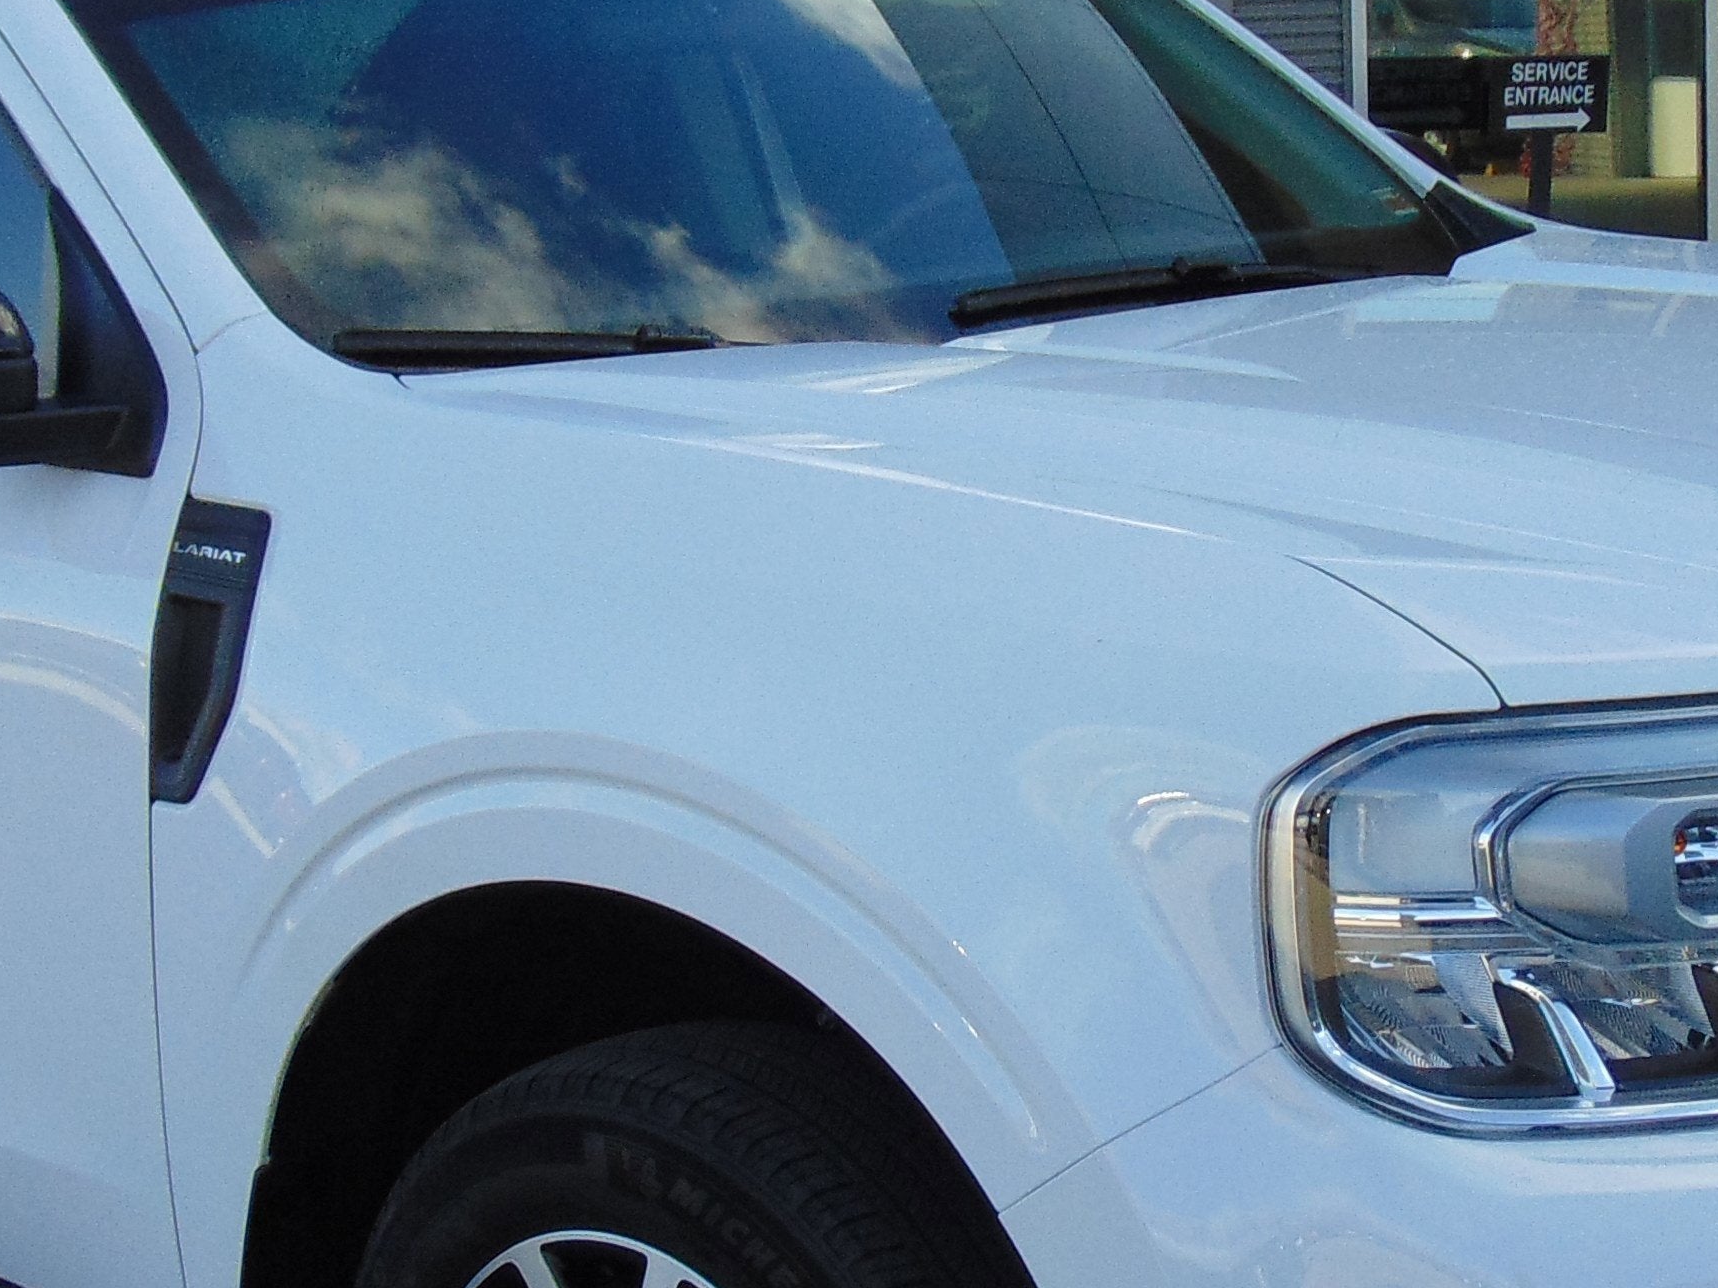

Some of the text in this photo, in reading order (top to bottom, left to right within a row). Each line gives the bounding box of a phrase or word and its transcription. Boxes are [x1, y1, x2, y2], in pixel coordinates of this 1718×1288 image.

[1510, 60, 1589, 82] SERVICE
[1503, 83, 1595, 108] ENTRANCE
[172, 541, 247, 564] LARIAT
